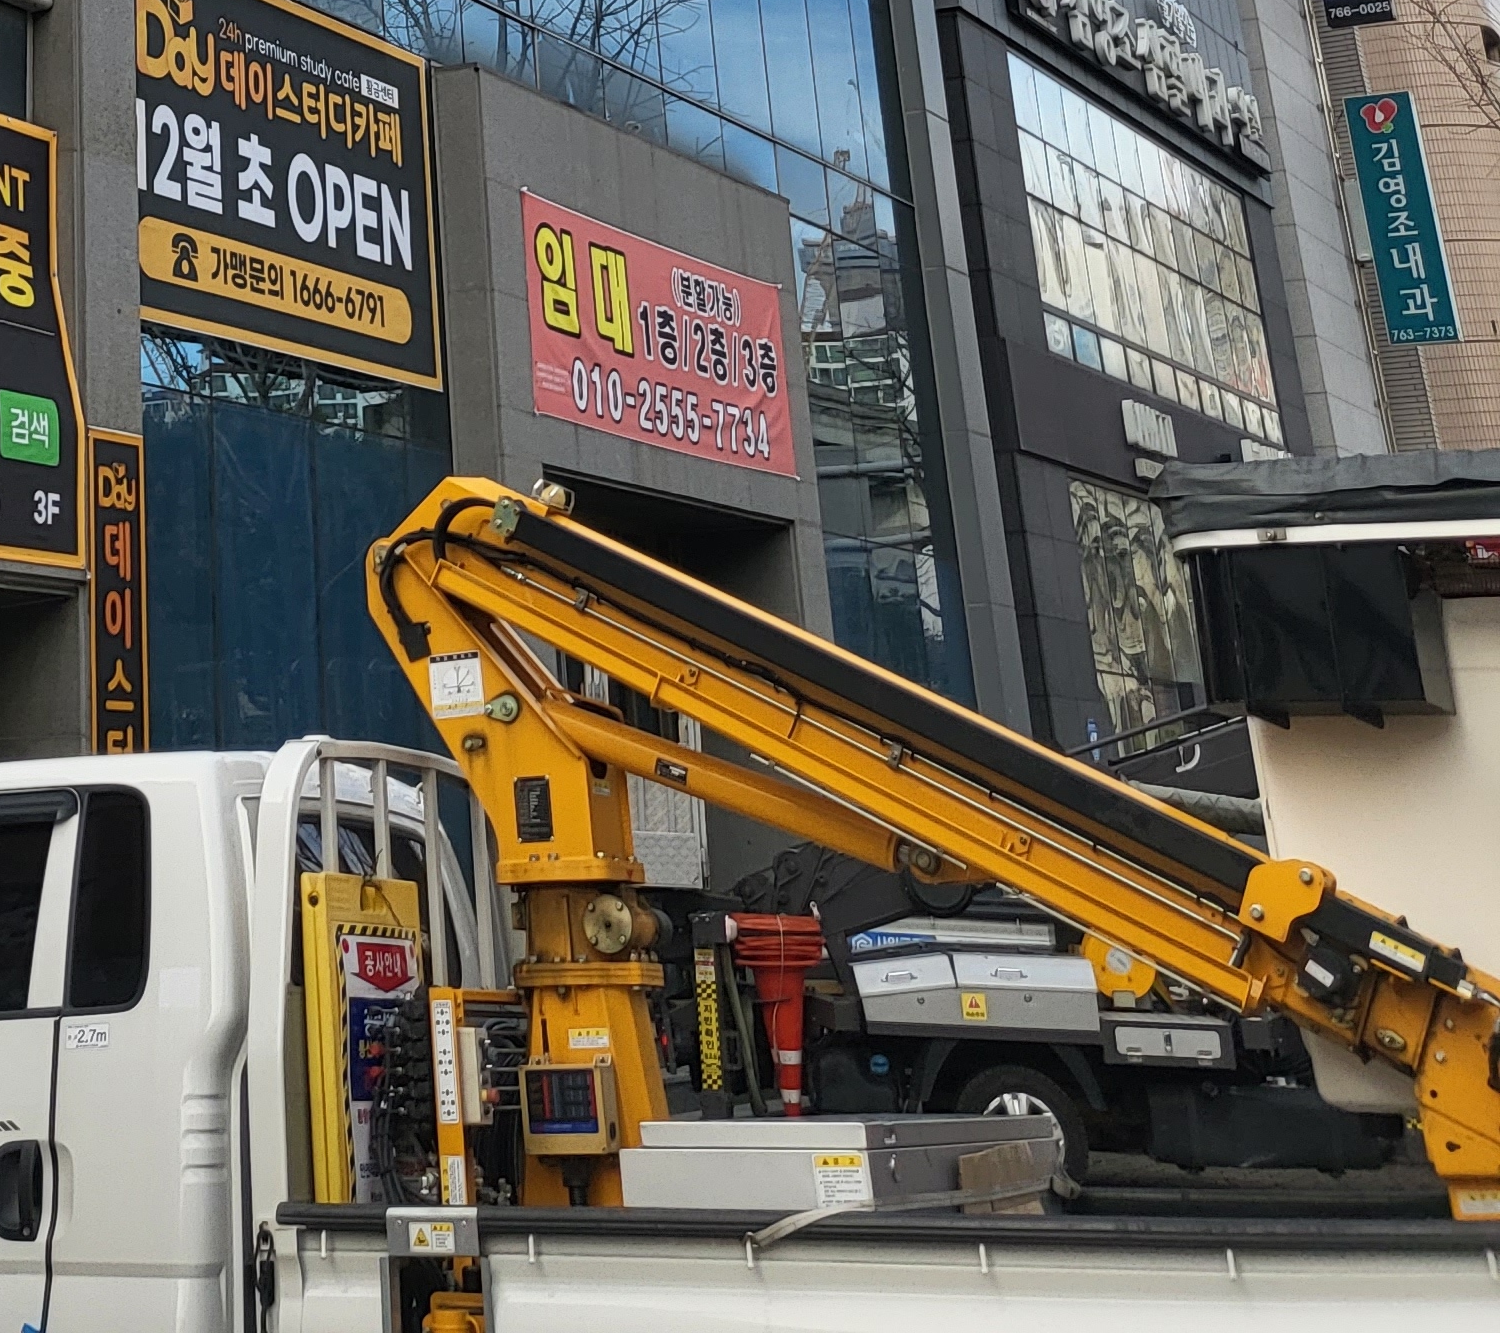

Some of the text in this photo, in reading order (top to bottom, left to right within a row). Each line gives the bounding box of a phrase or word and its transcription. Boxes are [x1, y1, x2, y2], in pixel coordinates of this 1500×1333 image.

[1328, 0, 1390, 19] 766-0025
[218, 17, 360, 92] 24h premium study cafe
[219, 49, 402, 168] 데이스터디카페
[365, 78, 395, 104] 황금센터
[237, 133, 276, 228] 초
[287, 152, 413, 271] OPEN
[1371, 139, 1439, 322] 김영조내과
[210, 245, 385, 328] 가맹문의 1666-6791
[1391, 326, 1456, 342] 763-7373
[10, 407, 50, 449] 검색
[571, 356, 771, 460] 010-2555-7734
[33, 489, 61, 525] 3F
[97, 464, 136, 511] Day
[364, 950, 403, 978] 공사안내
[78, 1028, 107, 1043] 2.7m
